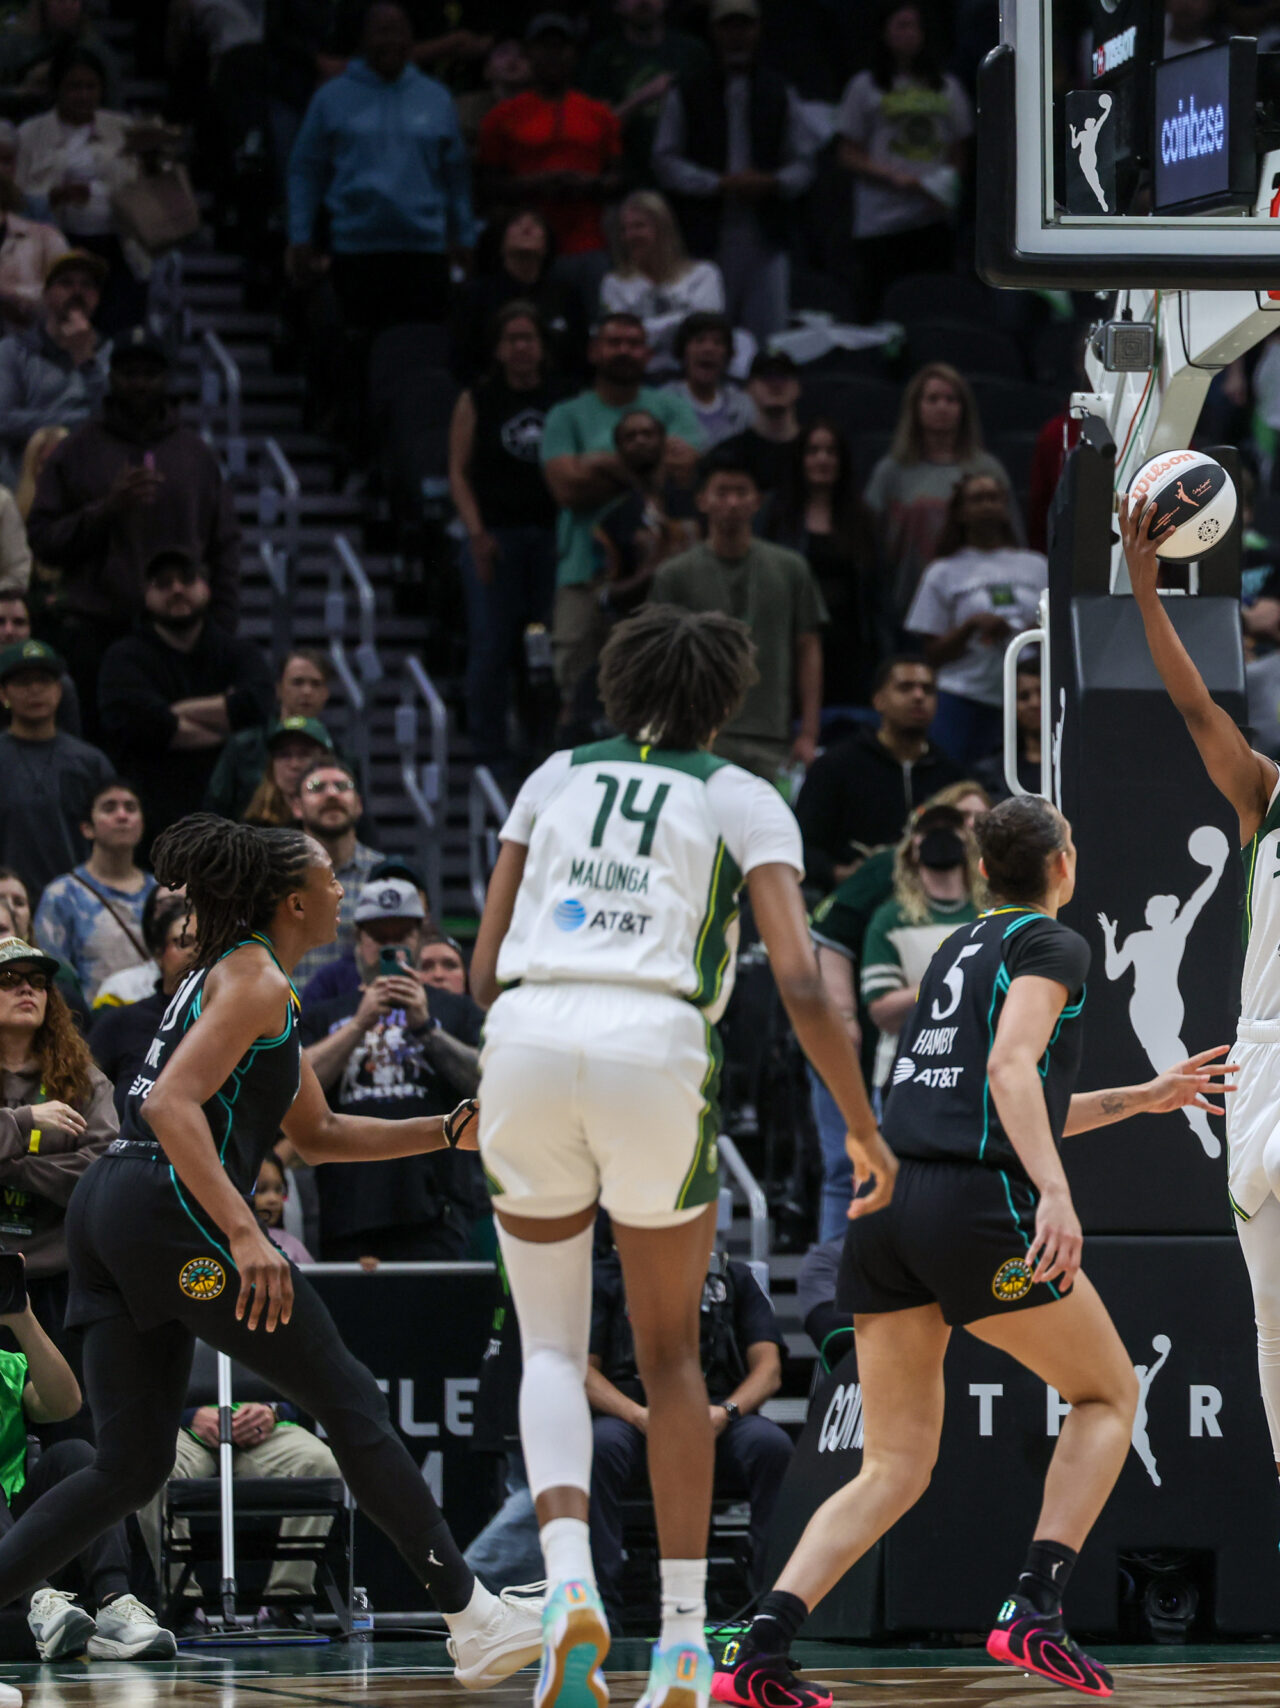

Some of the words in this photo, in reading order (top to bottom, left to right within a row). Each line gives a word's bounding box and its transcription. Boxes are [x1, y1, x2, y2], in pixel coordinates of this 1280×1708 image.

[1161, 94, 1224, 166] coinbase
[1132, 453, 1196, 499] Wilson
[591, 773, 672, 857] 14
[568, 858, 650, 895] MALONGA
[588, 910, 652, 936] AT&T
[931, 943, 984, 1021] 5
[911, 1026, 959, 1056] HAMBY
[913, 1066, 965, 1089] AT&T
